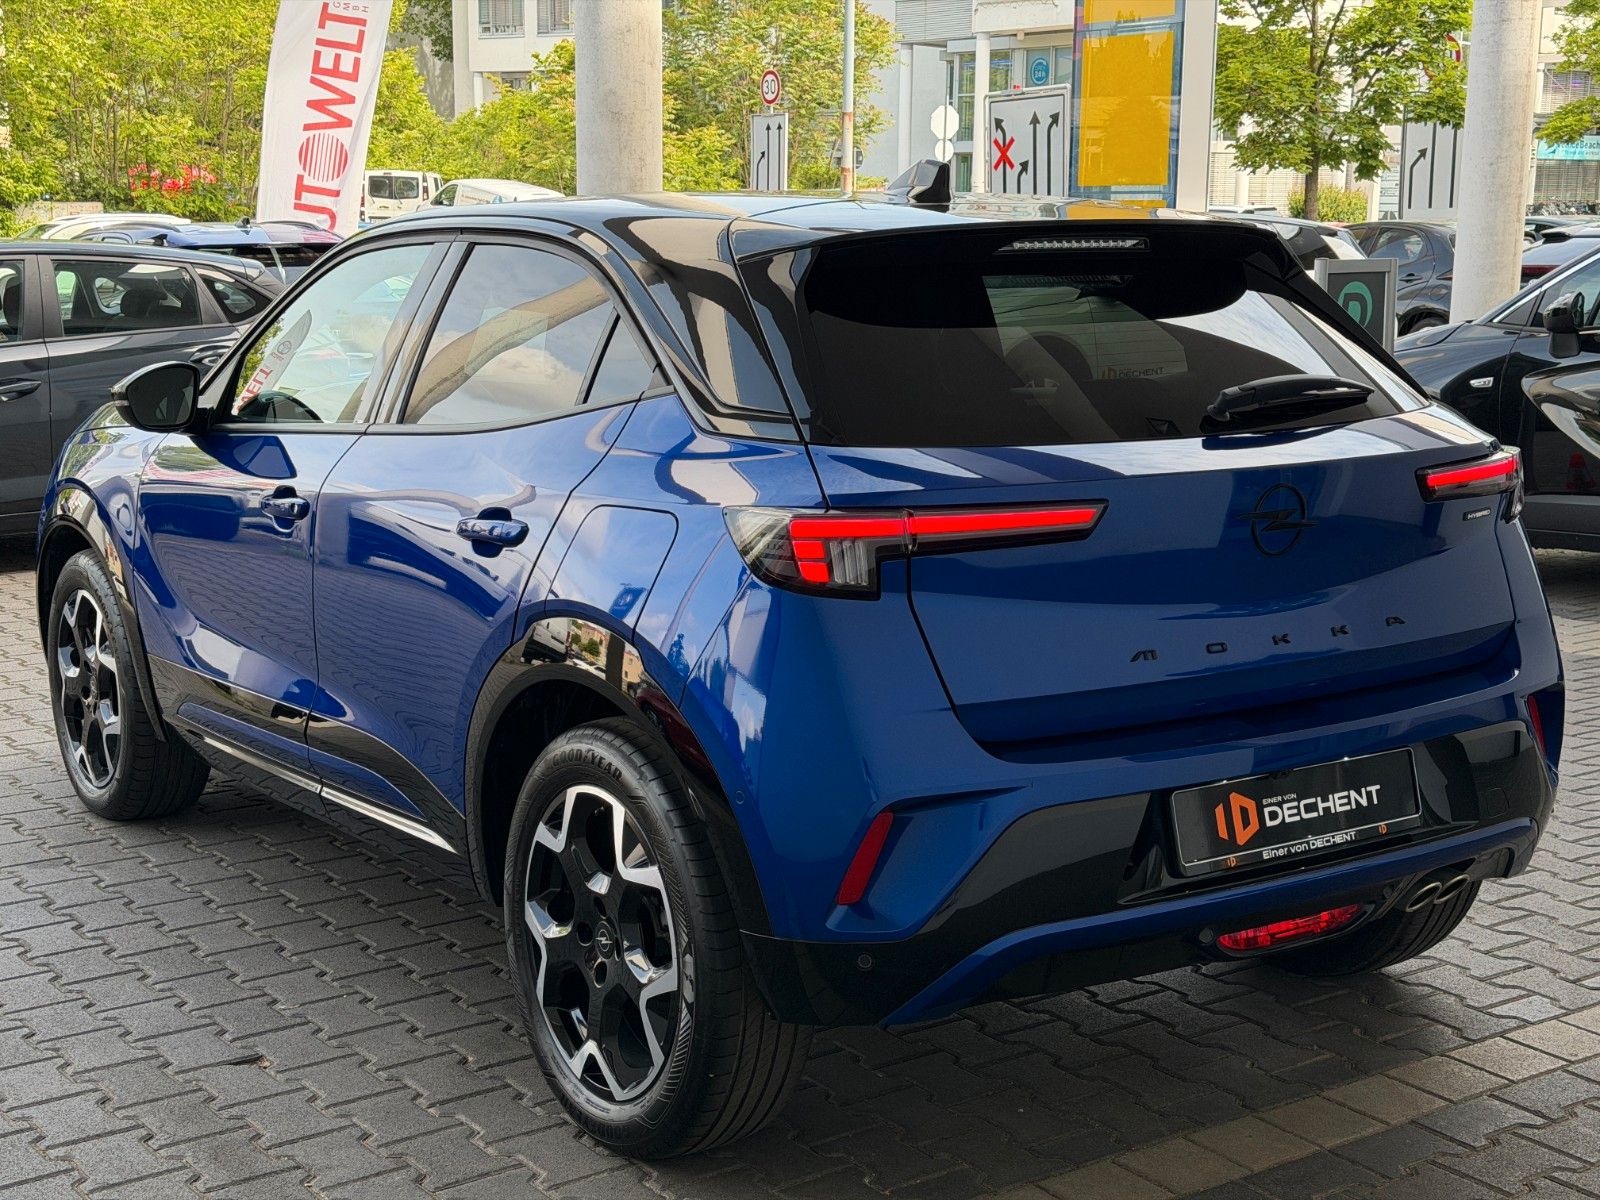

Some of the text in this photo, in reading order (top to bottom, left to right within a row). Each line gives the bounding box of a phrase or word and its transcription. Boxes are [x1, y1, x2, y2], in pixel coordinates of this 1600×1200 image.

[764, 79, 775, 95] 30
[293, 2, 368, 231] UTOWELT
[1130, 616, 1405, 662] MOKKA
[552, 748, 622, 781] GOODYEAR
[1263, 793, 1297, 805] EINER VON
[1263, 785, 1381, 827] DECHENT
[1263, 847, 1289, 859] Einer
[1290, 843, 1308, 853] von
[1310, 831, 1357, 849] DECHENT
